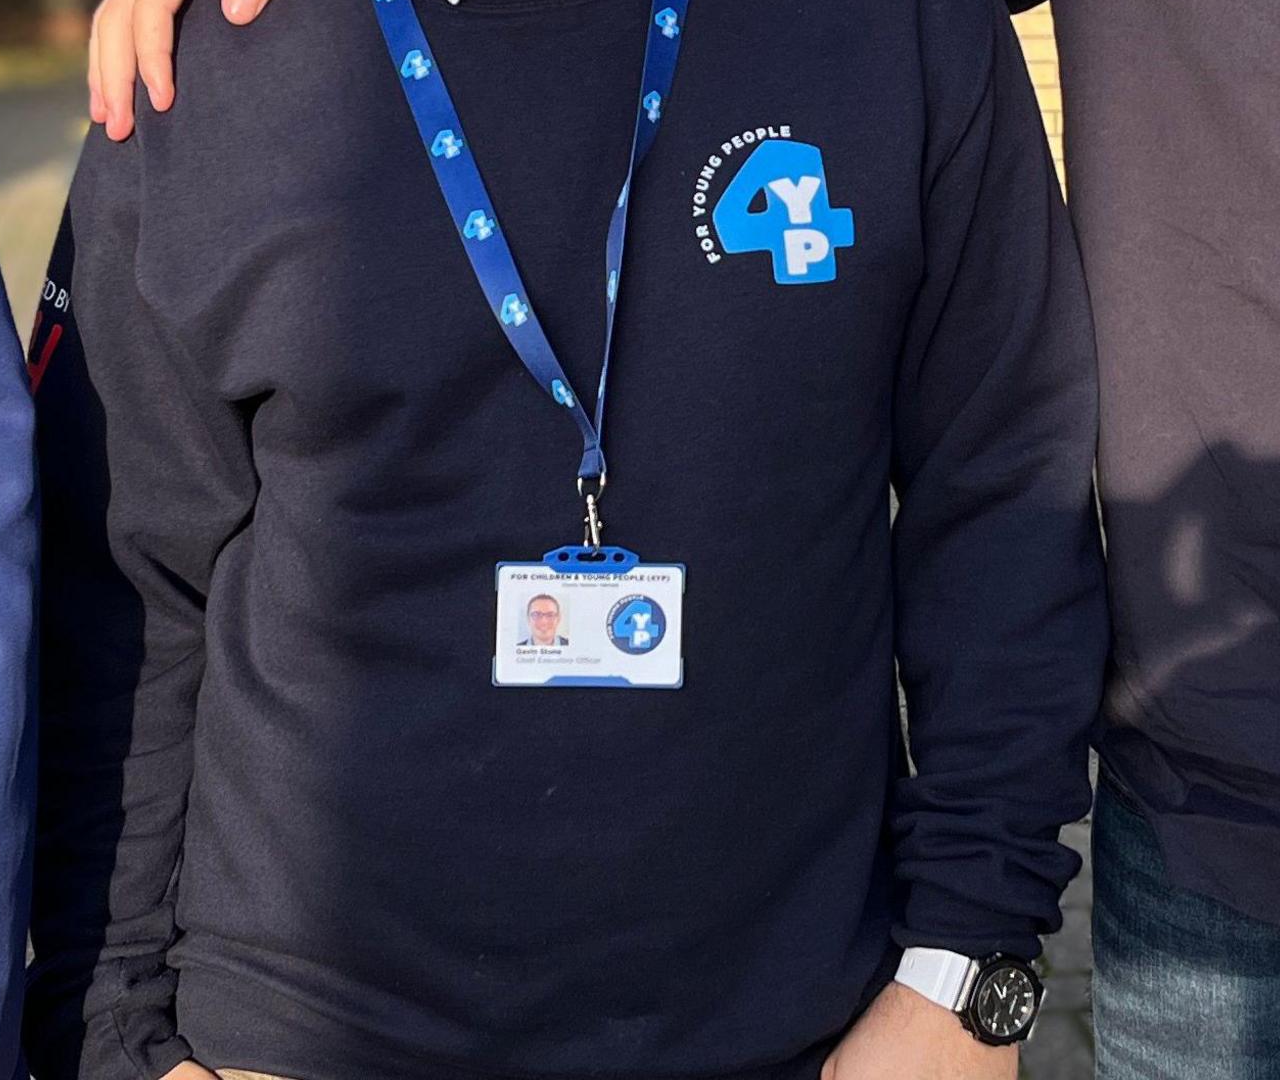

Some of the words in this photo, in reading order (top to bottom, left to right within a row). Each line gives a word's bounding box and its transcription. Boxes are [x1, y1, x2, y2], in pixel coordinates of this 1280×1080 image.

[720, 124, 792, 157] PEOPLE
[692, 154, 723, 218] YOUNG
[695, 223, 722, 265] FOR
[582, 573, 611, 581] YOUNG
[613, 573, 645, 582] PEOPLE
